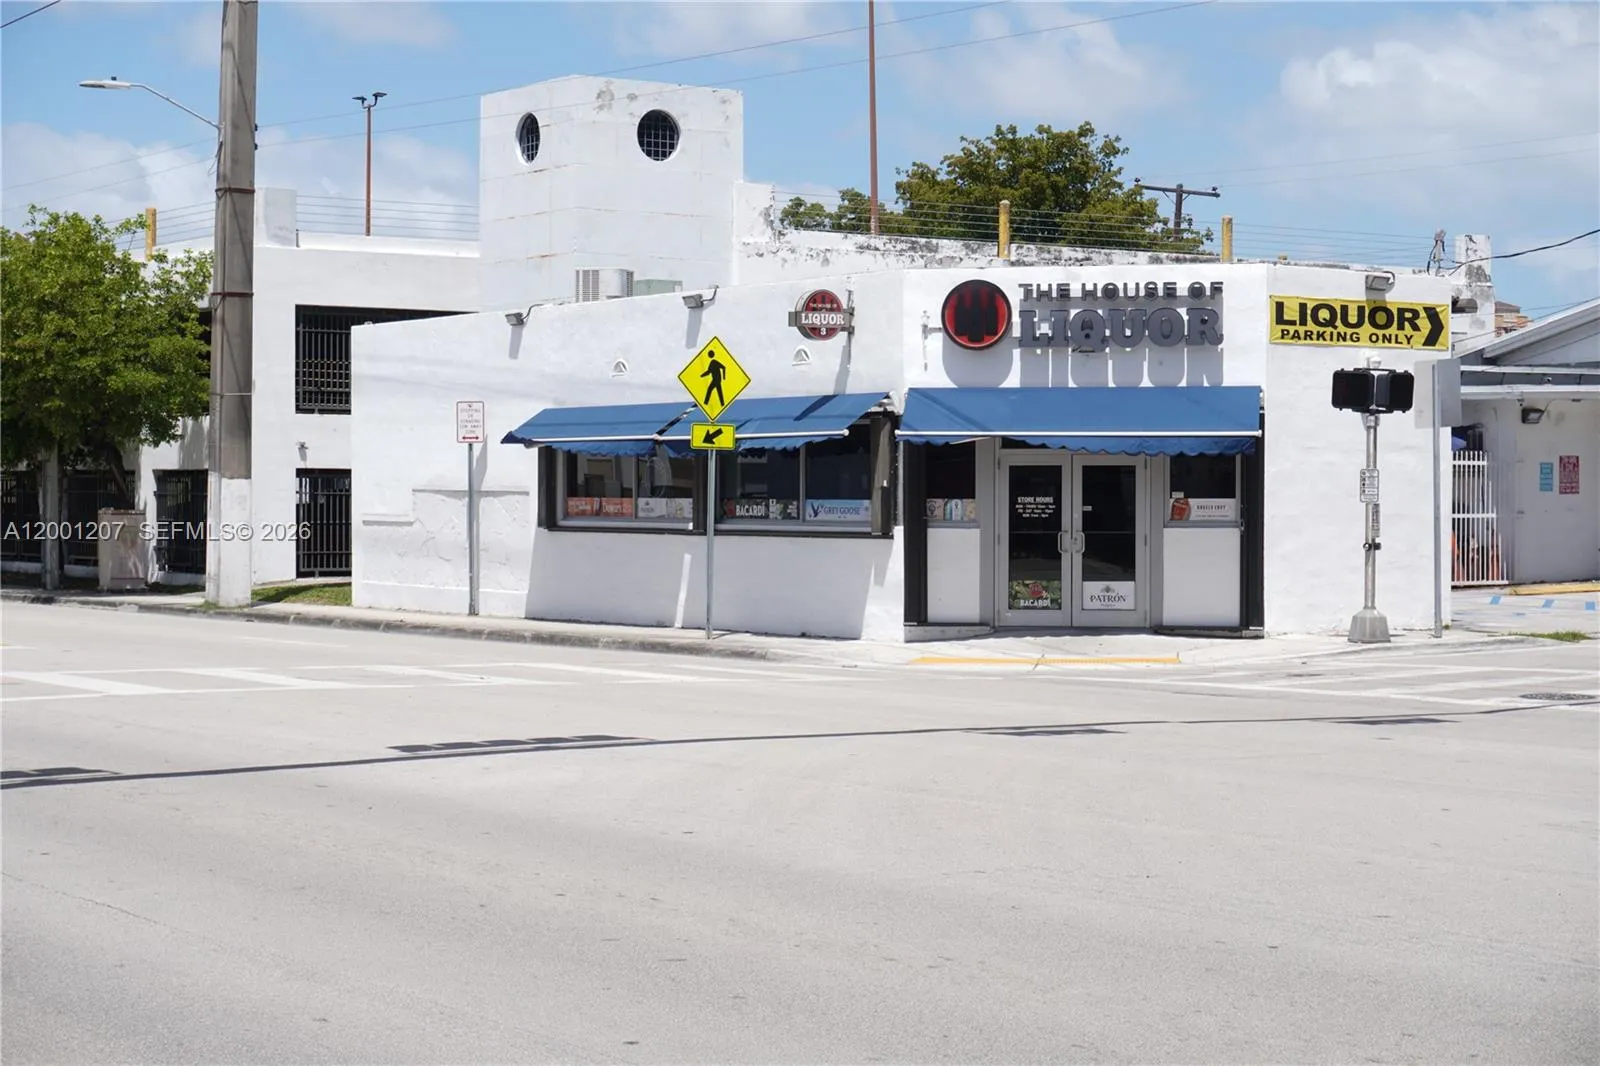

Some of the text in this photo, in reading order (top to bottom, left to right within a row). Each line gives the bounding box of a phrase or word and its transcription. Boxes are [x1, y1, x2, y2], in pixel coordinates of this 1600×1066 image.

[1018, 281, 1224, 301] THE HOUSE OF
[801, 313, 845, 325] LIQUOR
[1275, 301, 1422, 332] LIQUOR
[820, 327, 827, 336] 3
[1018, 307, 1224, 349] LIQUOR
[1280, 329, 1415, 345] PARKING ONLY
[735, 502, 765, 516] BACARDÍ
[840, 506, 860, 516] GOOSE
[1089, 592, 1127, 603] PATRÓN
